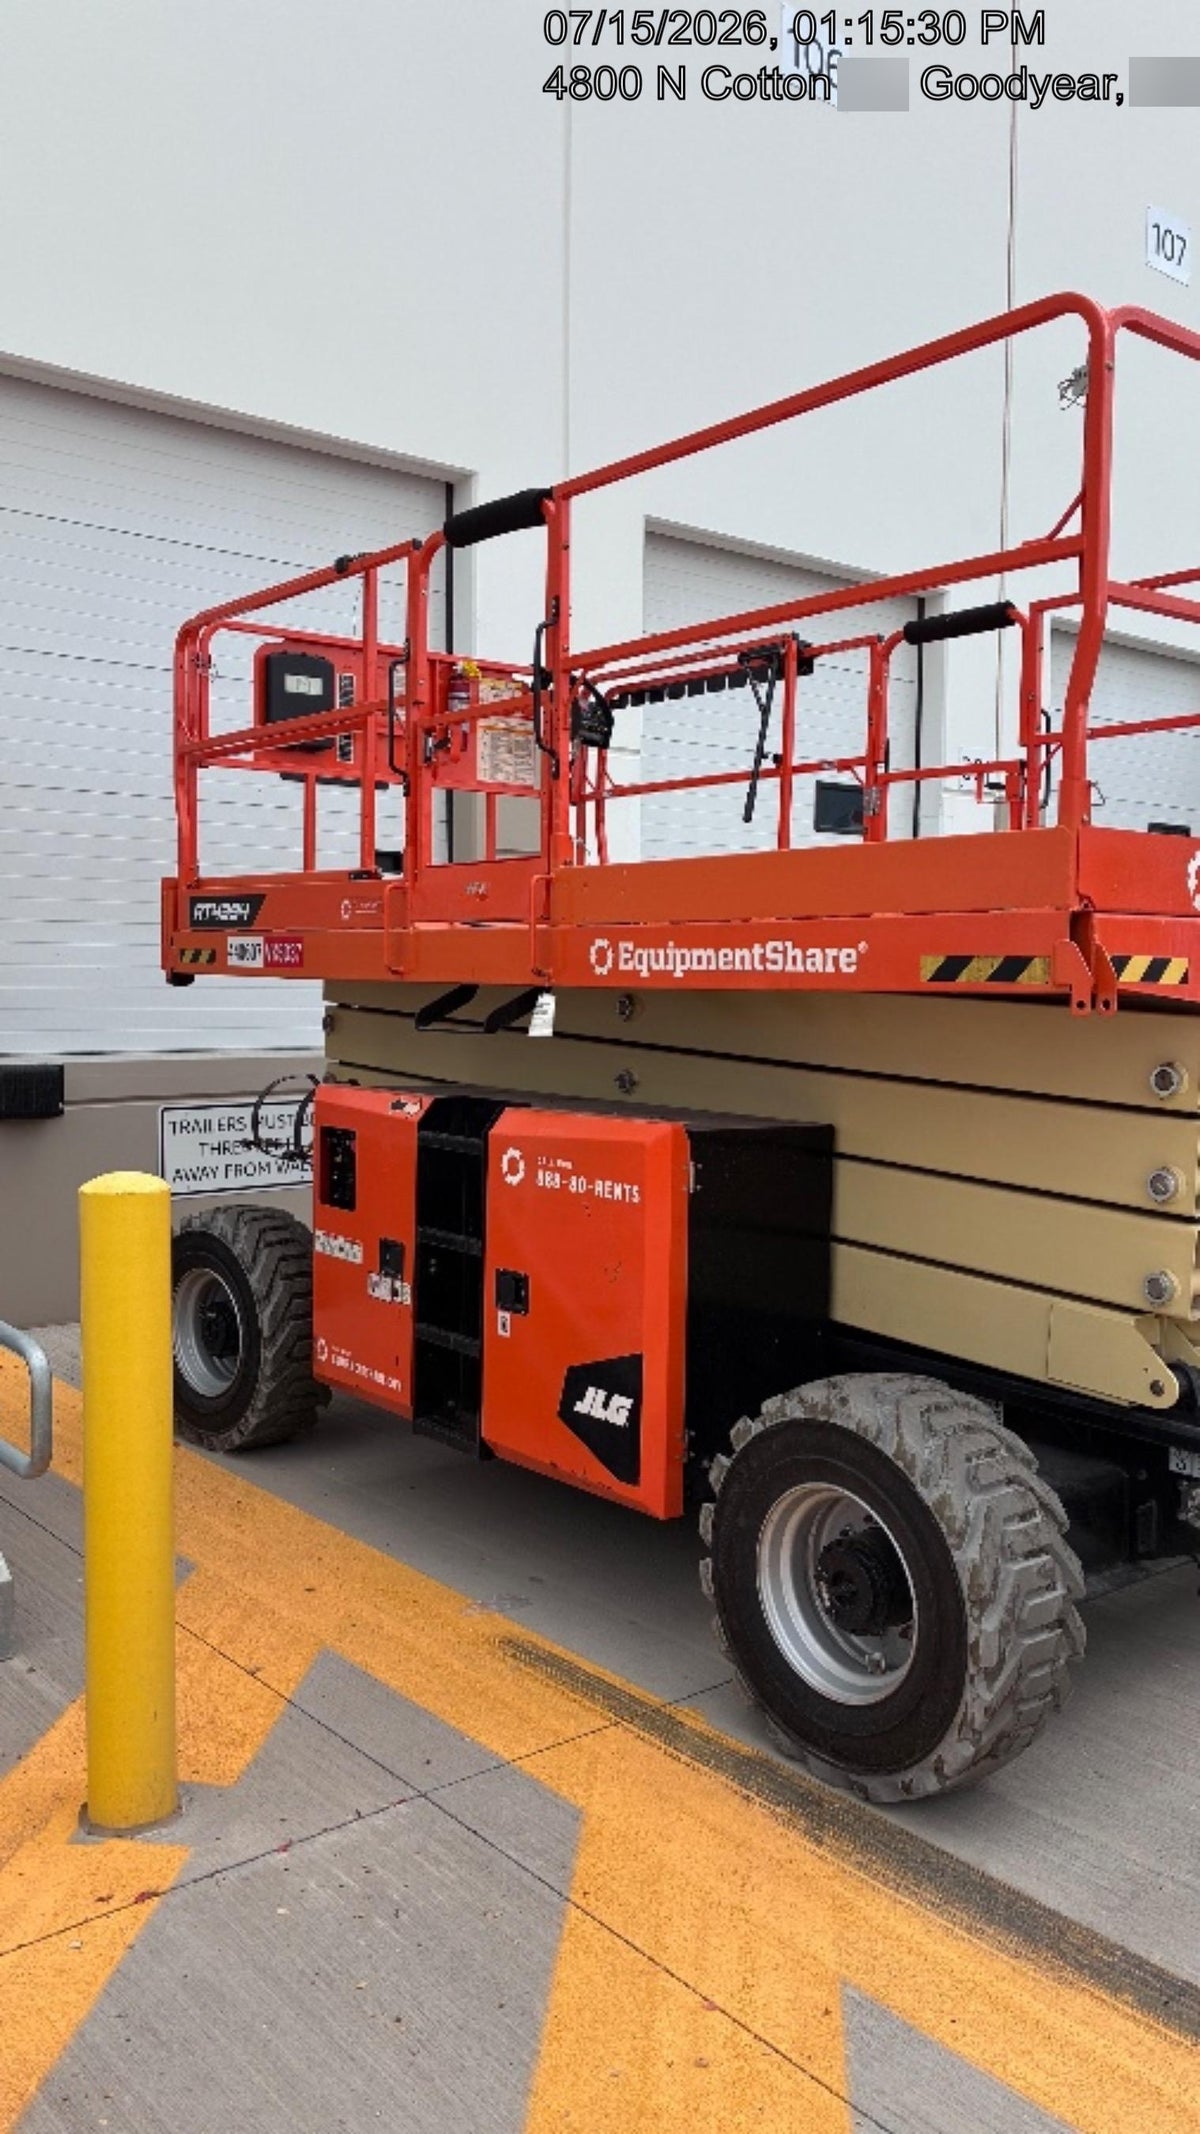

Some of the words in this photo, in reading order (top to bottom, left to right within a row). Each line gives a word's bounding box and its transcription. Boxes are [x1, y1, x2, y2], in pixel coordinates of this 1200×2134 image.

[1152, 222, 1187, 267] 107
[168, 1116, 248, 1135] TRAILERS
[172, 1164, 220, 1182] AWAY
[224, 1160, 271, 1179] FROM
[574, 1386, 634, 1427] JLG
